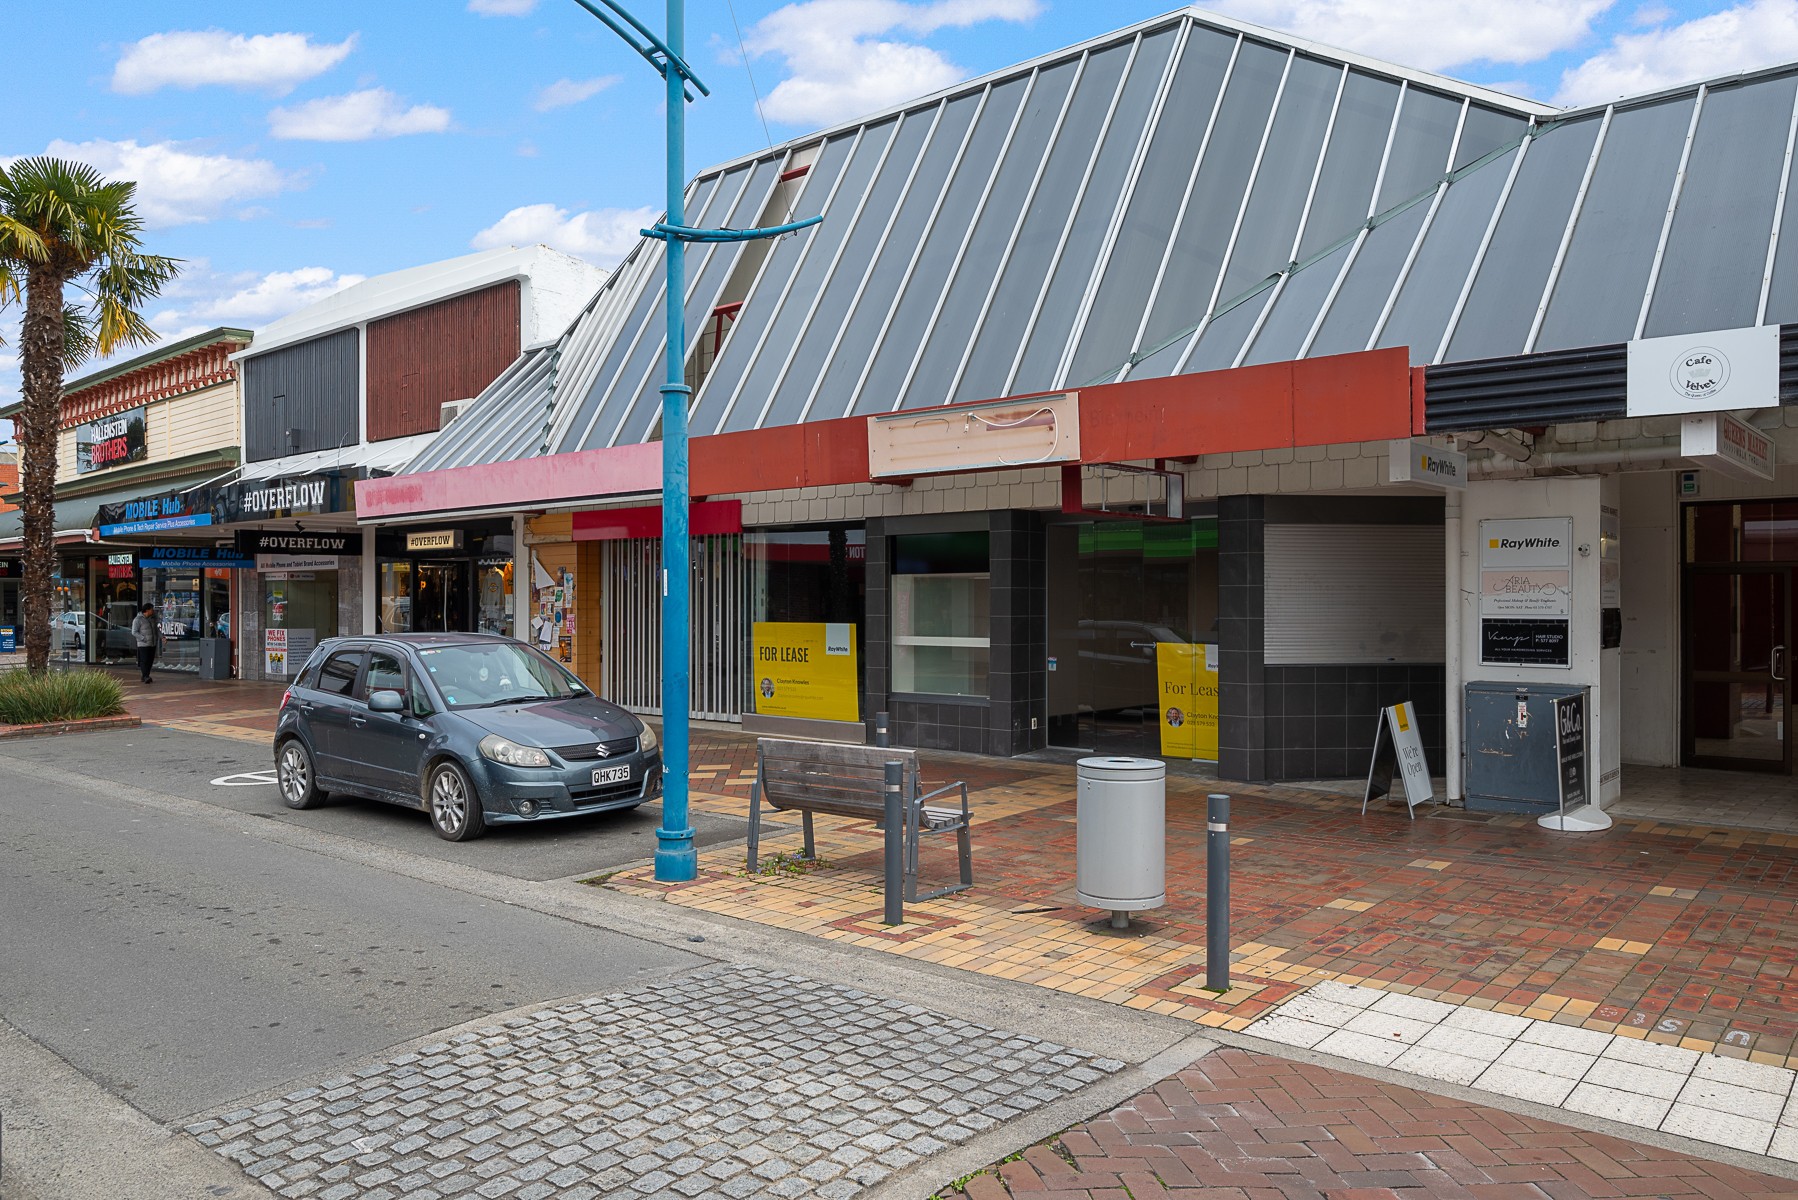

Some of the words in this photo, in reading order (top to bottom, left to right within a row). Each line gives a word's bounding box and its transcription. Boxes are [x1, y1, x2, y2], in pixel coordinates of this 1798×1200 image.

[1686, 356, 1712, 367] Cafe
[1686, 379, 1716, 390] Velvet
[90, 419, 127, 443] HALLENSTEIN
[91, 436, 128, 464] BROTHERS
[244, 481, 325, 512] #OVERFLOW
[126, 500, 158, 519] MOBILE
[162, 496, 180, 515] Hub
[259, 537, 345, 549] #OVERFLOW
[410, 536, 450, 547] #OVERFLOW
[1501, 538, 1560, 550] RayWhite
[108, 554, 132, 564] HALLENSTEIN
[152, 548, 210, 558] MOBILE
[108, 565, 133, 578] BROTHERS
[1499, 576, 1530, 587] ARIA
[1505, 583, 1548, 594] BEAUTY
[759, 646, 777, 661] FOR
[780, 647, 809, 662] LEASE
[1165, 681, 1186, 695] For
[1403, 746, 1418, 760] We're
[594, 767, 628, 783] QHK735
[1407, 762, 1422, 777] Open
